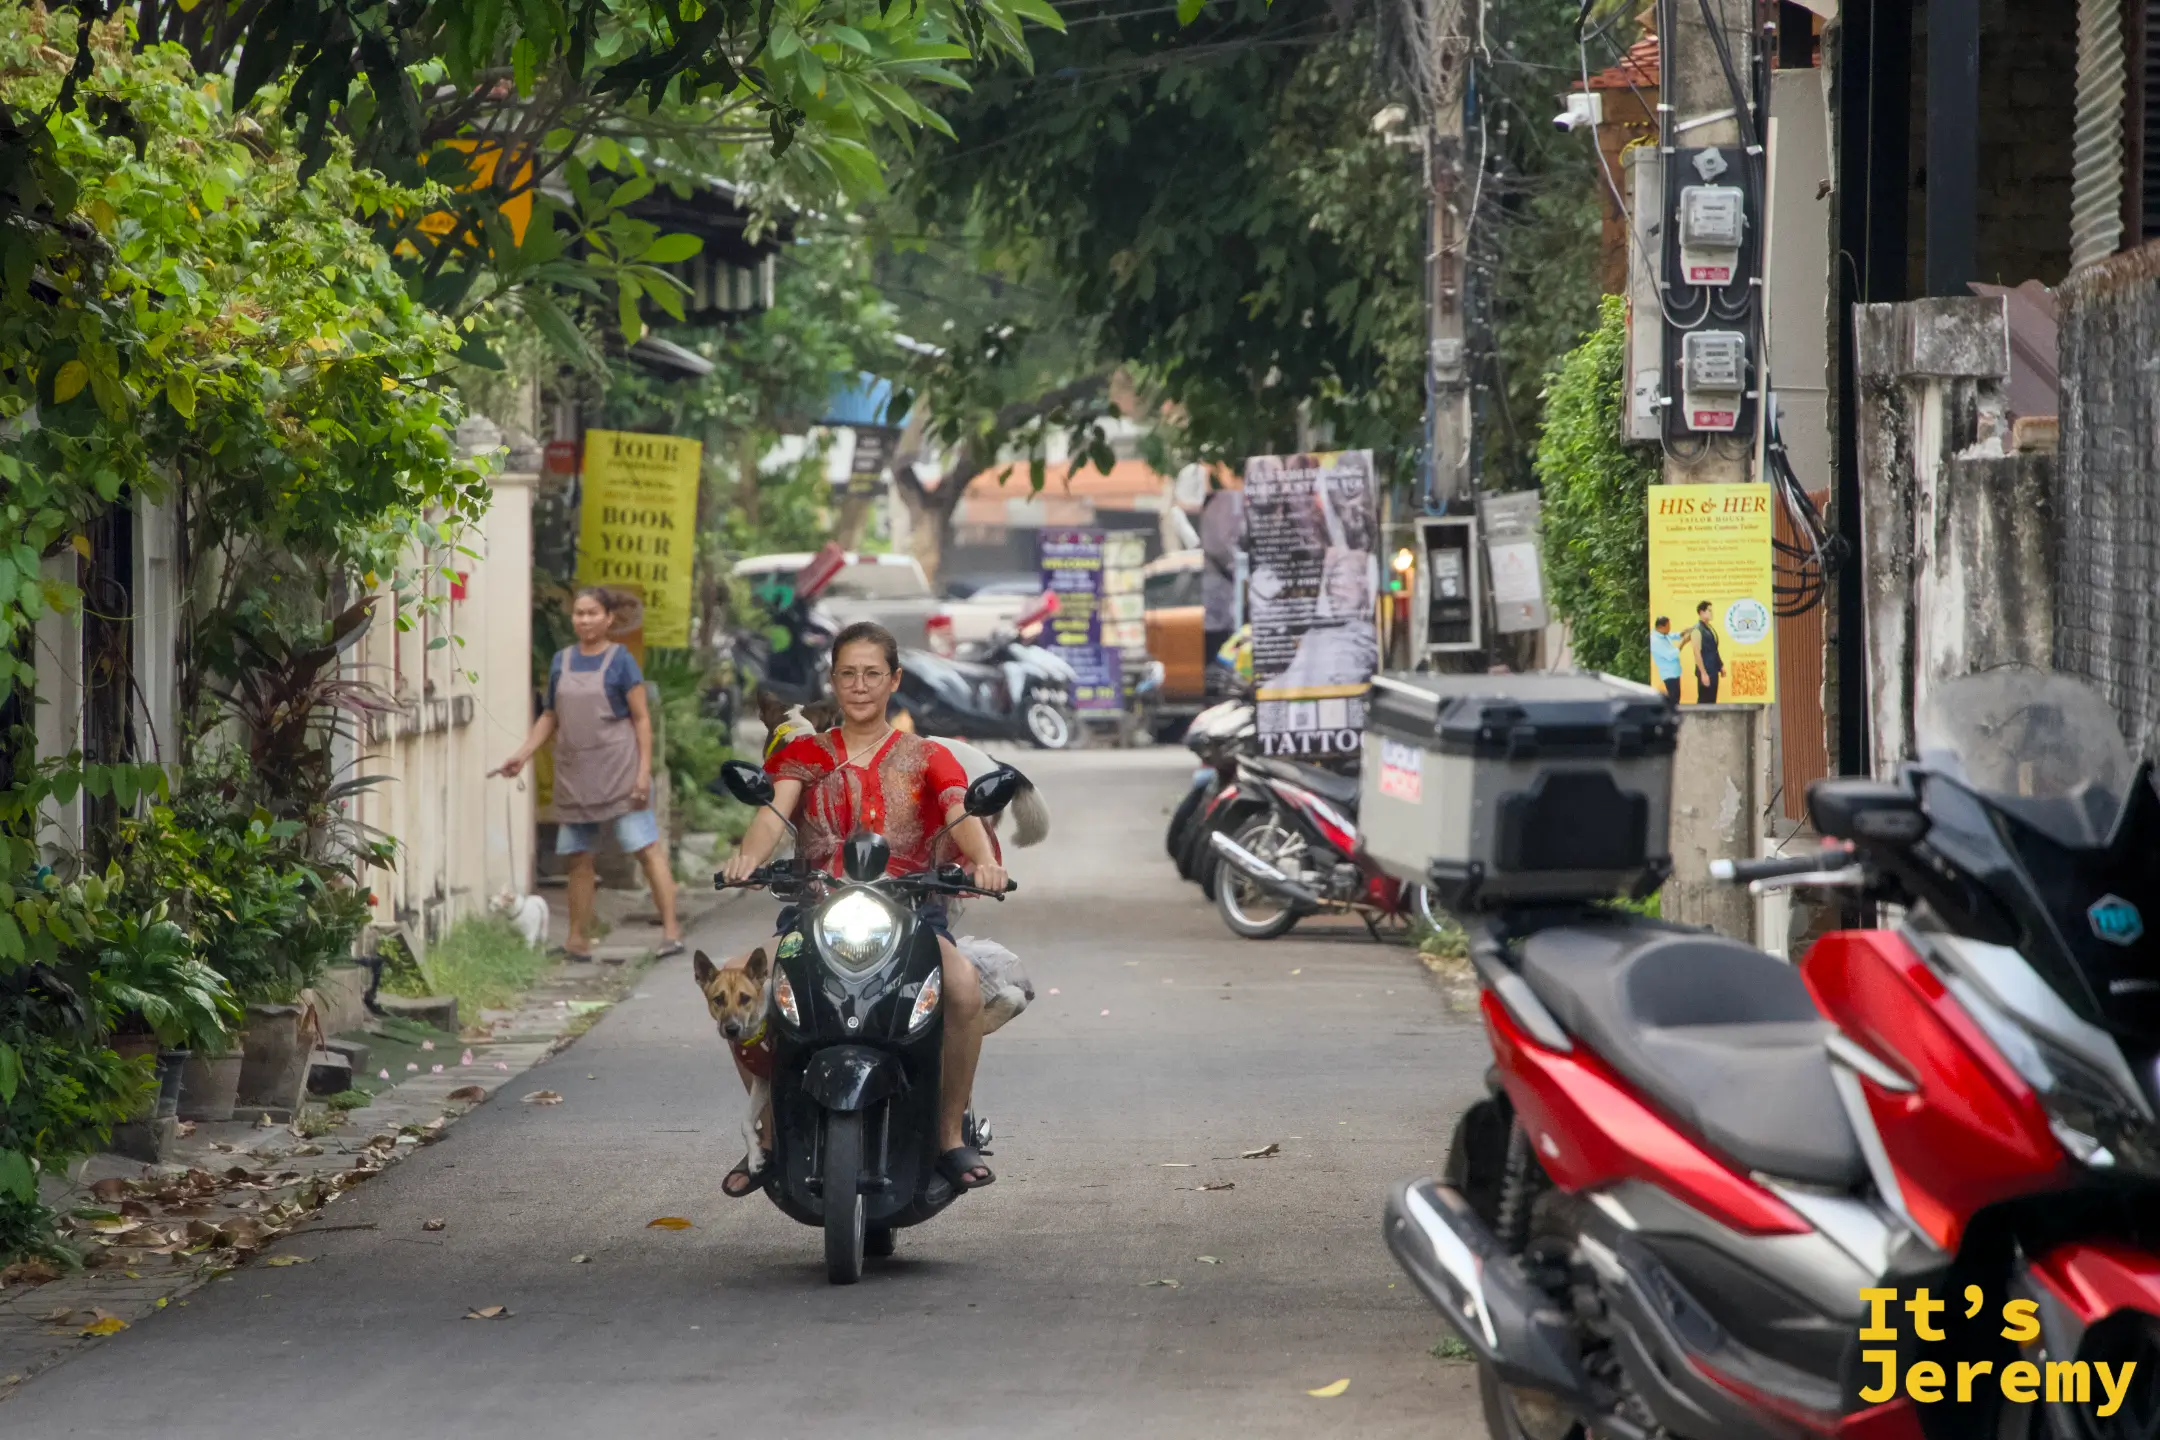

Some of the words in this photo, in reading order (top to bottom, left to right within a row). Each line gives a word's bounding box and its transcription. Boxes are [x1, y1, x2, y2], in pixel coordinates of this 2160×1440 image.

[608, 437, 679, 462] TOUR
[1659, 497, 1695, 515] HIS
[1700, 496, 1717, 514] &
[1723, 495, 1767, 514] HER
[602, 506, 675, 531] BOOK
[600, 532, 670, 557] YOUR
[595, 558, 669, 582] TOUR
[1258, 728, 1364, 756] TATTO
